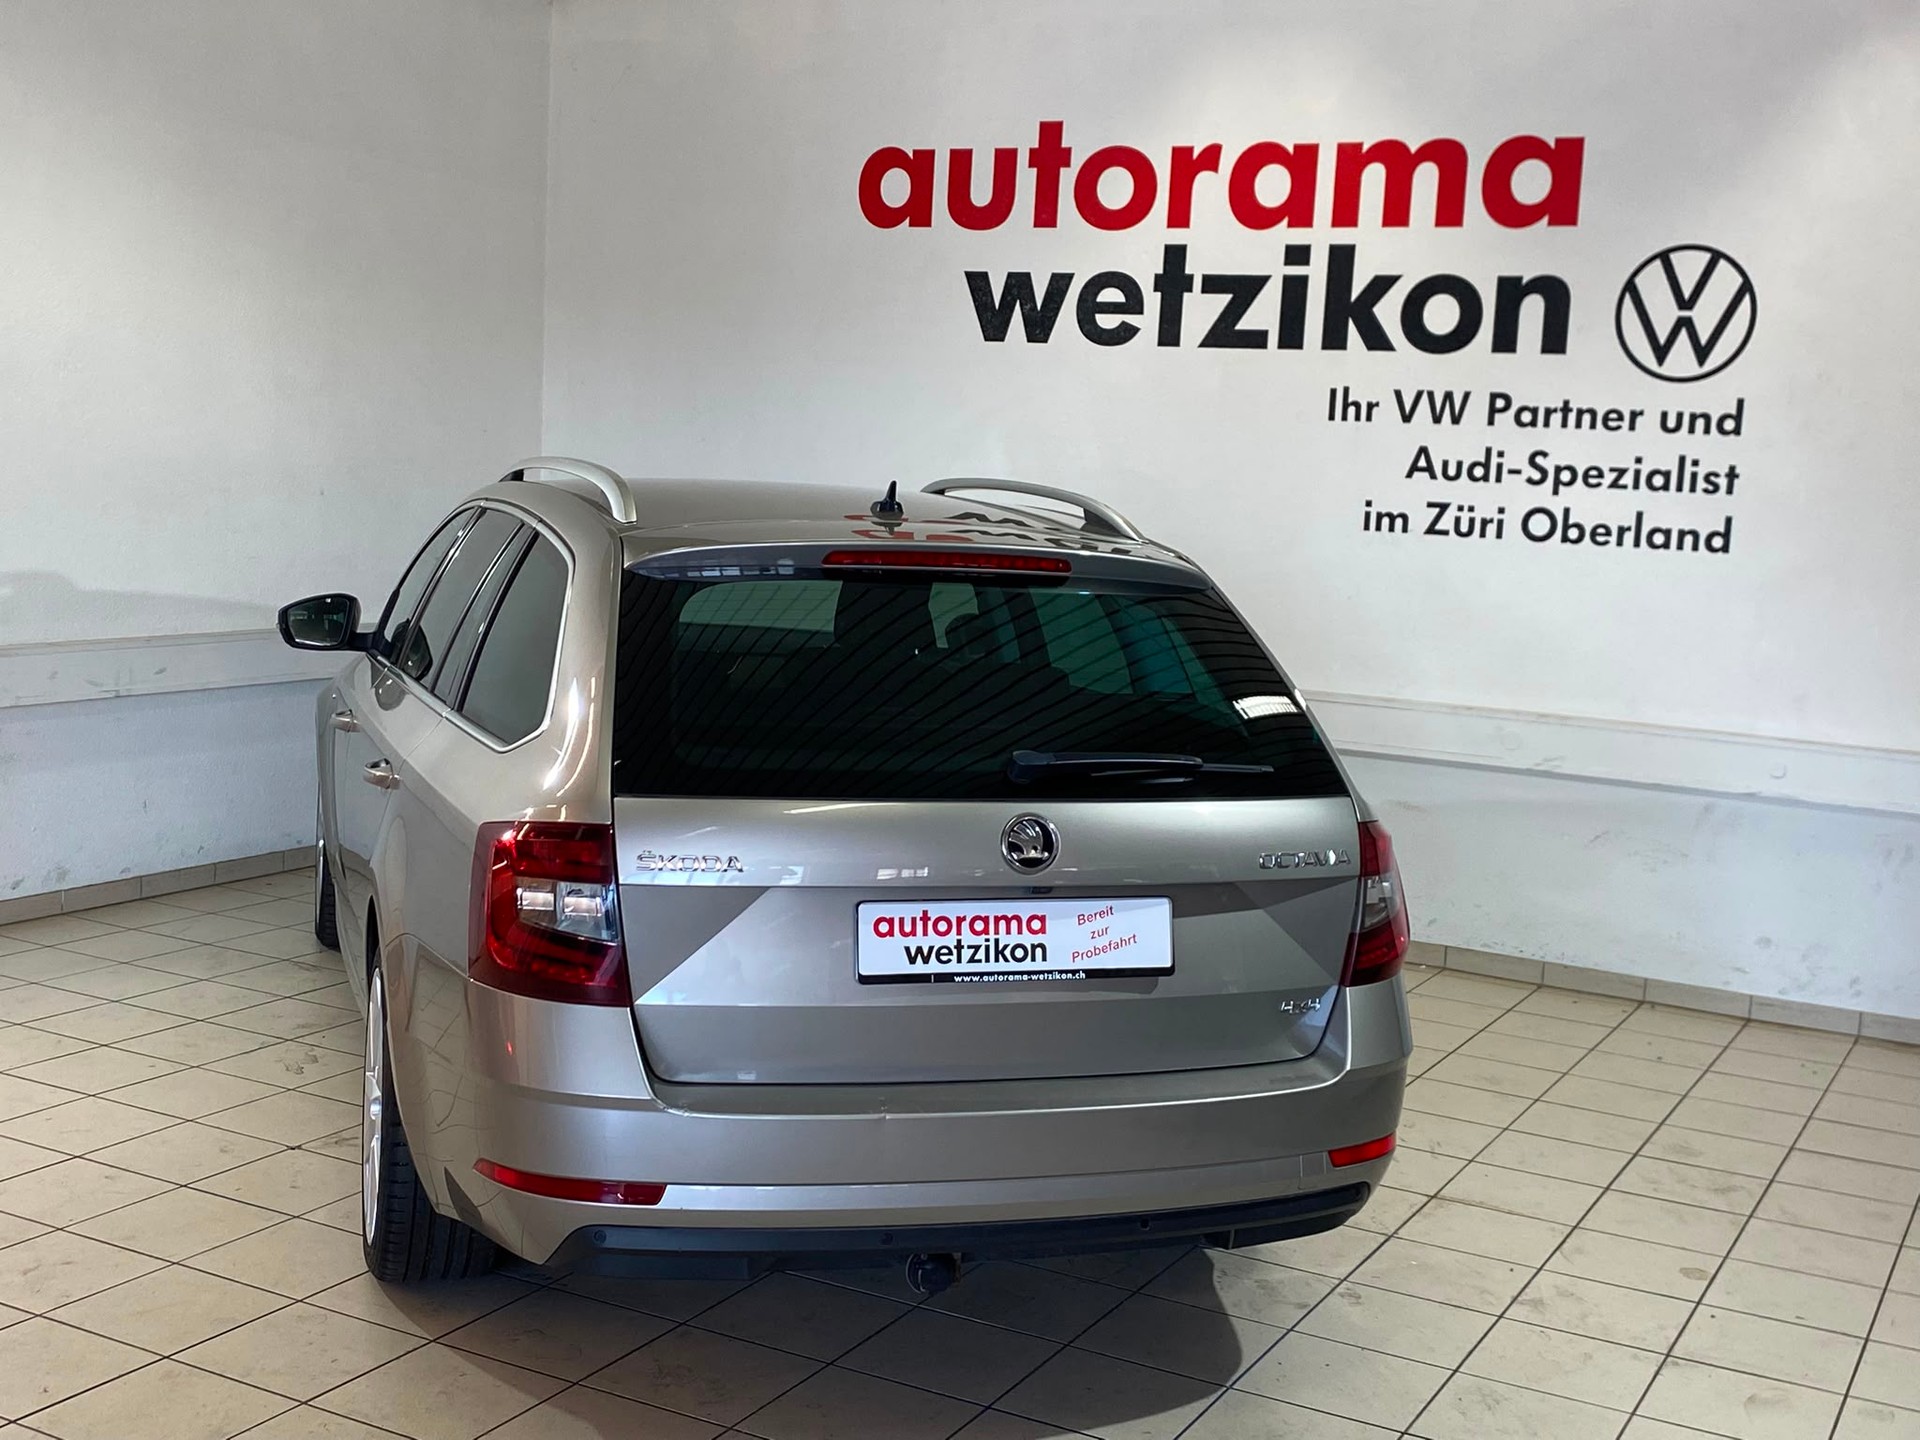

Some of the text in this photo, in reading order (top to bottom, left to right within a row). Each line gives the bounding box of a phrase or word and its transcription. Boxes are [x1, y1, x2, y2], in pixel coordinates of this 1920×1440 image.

[858, 120, 1585, 231] autorama
[964, 243, 1571, 355] wetzikon
[1328, 386, 1745, 437] Ihr VW Partner und
[1405, 445, 1740, 498] Audi-Spezialist
[1363, 500, 1733, 554] im Züri Oberland
[1259, 848, 1351, 869] OCTAVIA
[872, 909, 1047, 938] autorama
[1077, 905, 1114, 926] Bereit
[1090, 926, 1110, 940] zur
[903, 938, 1048, 965] wetzikon
[1071, 933, 1137, 963] Probefahrt
[954, 971, 1085, 982] www.autorama-wetzikon.ch
